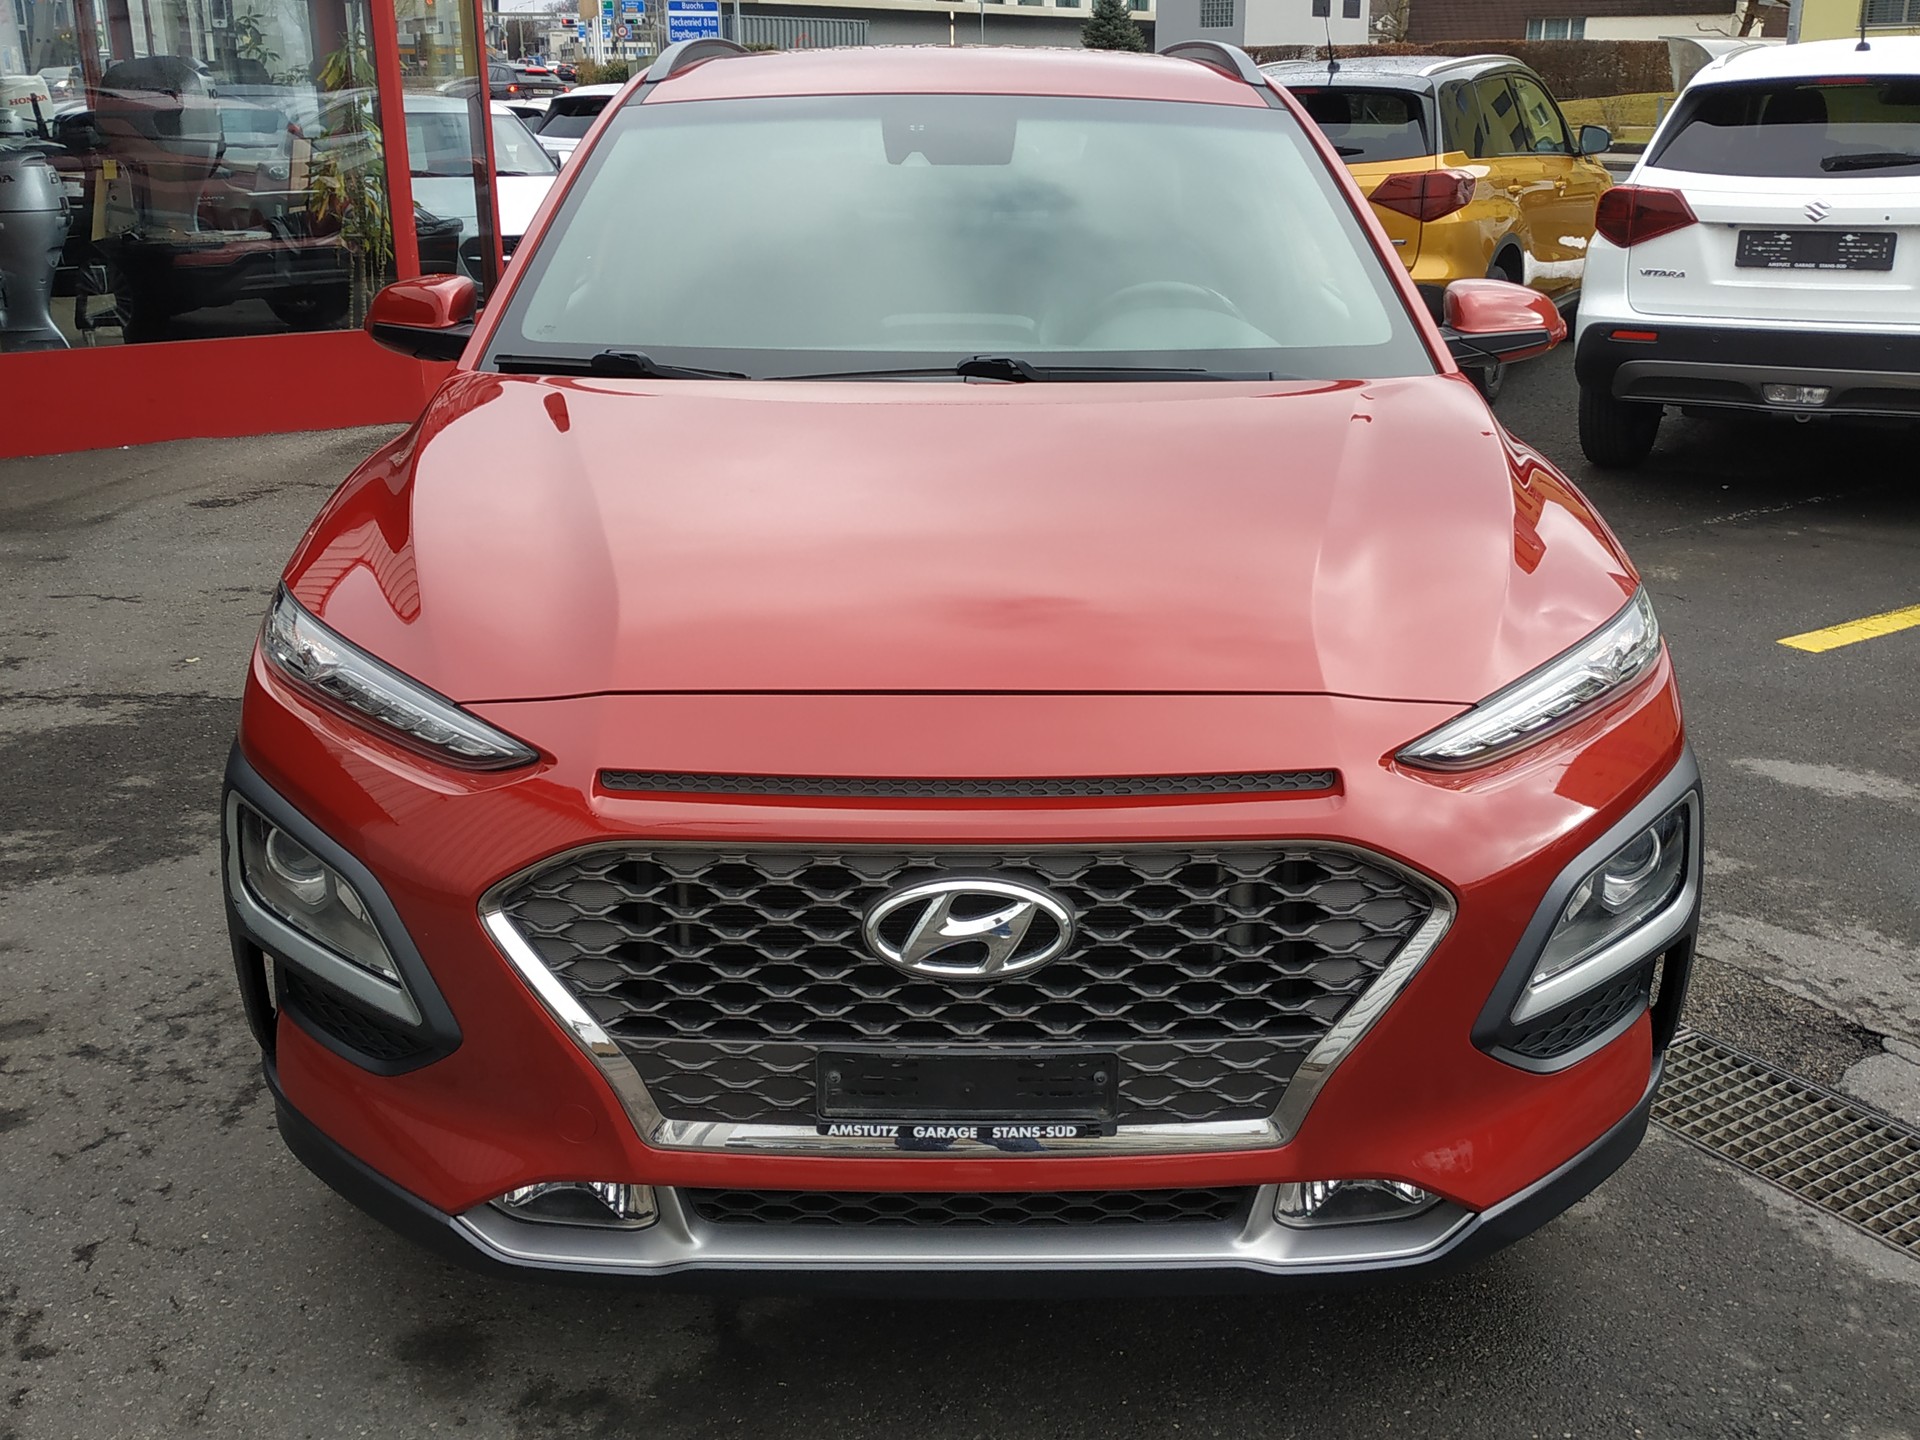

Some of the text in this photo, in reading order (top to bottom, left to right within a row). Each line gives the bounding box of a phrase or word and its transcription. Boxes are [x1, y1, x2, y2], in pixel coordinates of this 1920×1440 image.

[670, 17, 702, 27] Beckenried
[708, 17, 717, 27] km
[671, 29, 700, 40] Engelberg
[709, 29, 718, 38] km
[207, 88, 218, 100] 10
[48, 171, 59, 185] 8
[1639, 268, 1686, 279] VITARA
[827, 1124, 1078, 1139] AMSTUTZ GARAGE STANS-SÜD
